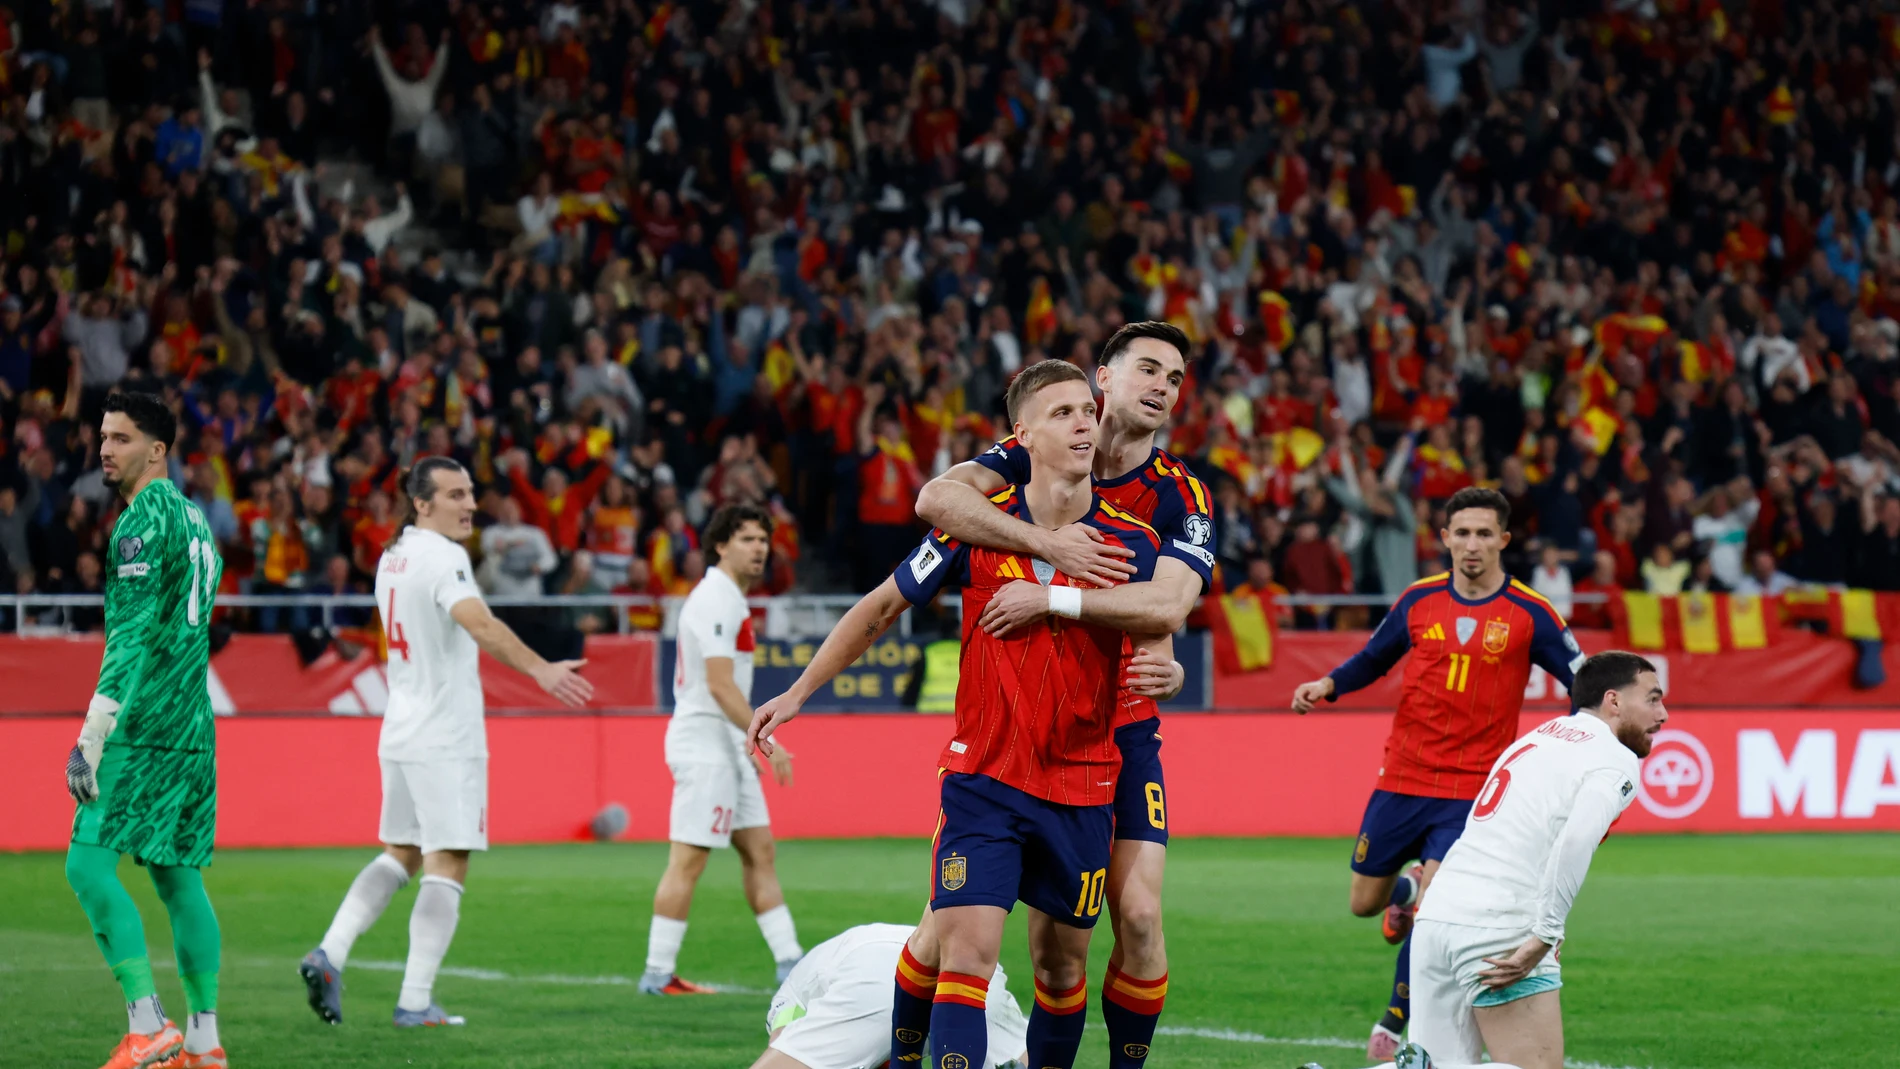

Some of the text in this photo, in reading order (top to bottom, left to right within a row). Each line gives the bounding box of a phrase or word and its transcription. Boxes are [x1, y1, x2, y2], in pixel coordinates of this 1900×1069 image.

[387, 587, 410, 662] 4
[833, 673, 881, 698] DE
[1446, 652, 1470, 692] 11
[1145, 782, 1165, 830] 8
[1473, 743, 1538, 822] 6
[1074, 867, 1106, 917] 10
